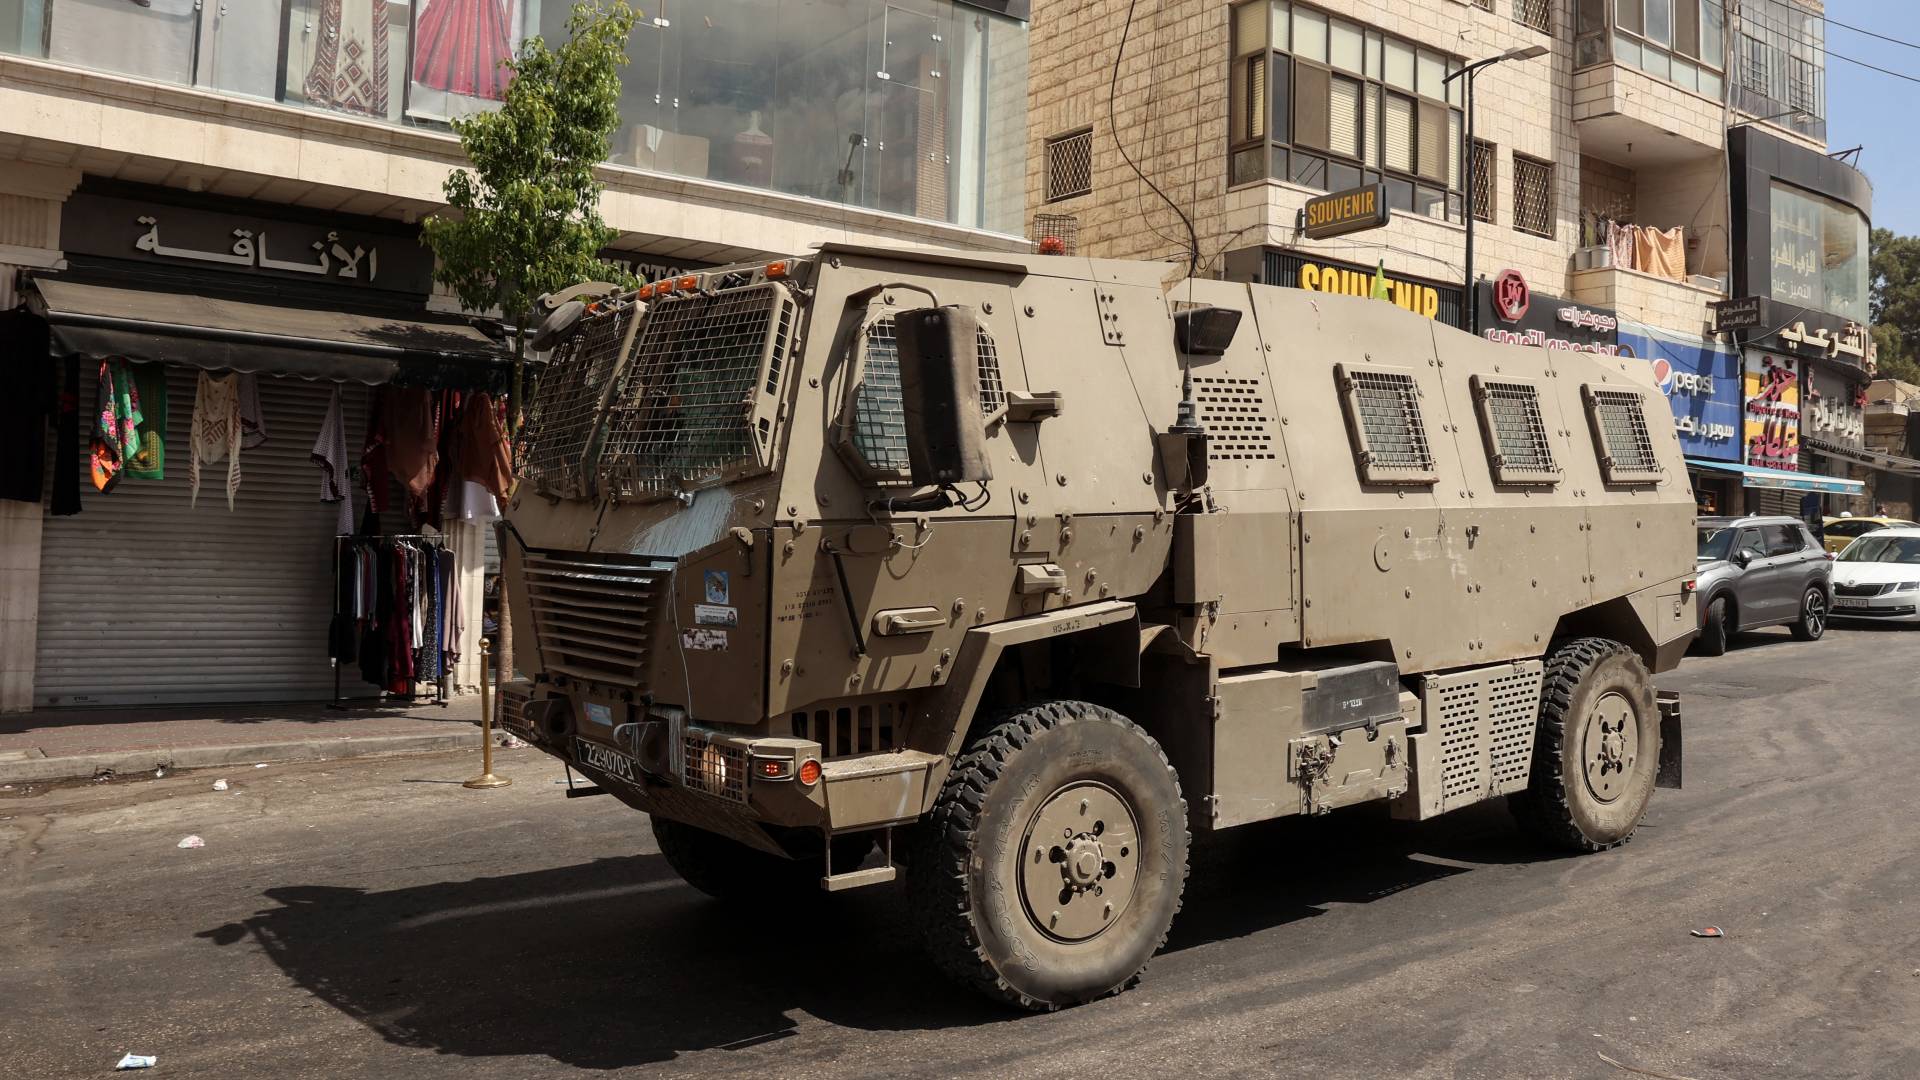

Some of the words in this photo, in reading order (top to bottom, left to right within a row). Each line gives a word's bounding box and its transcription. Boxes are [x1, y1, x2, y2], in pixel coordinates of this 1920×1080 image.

[1309, 191, 1374, 226] SOUVENIR
[135, 215, 377, 282] الأناقة
[1301, 263, 1438, 320] SOUVNIR
[1559, 306, 1616, 332] مجوهرات
[1778, 321, 1869, 363] الشرعي
[1673, 371, 1714, 396] pepsi
[1708, 422, 1734, 440] سوبر
